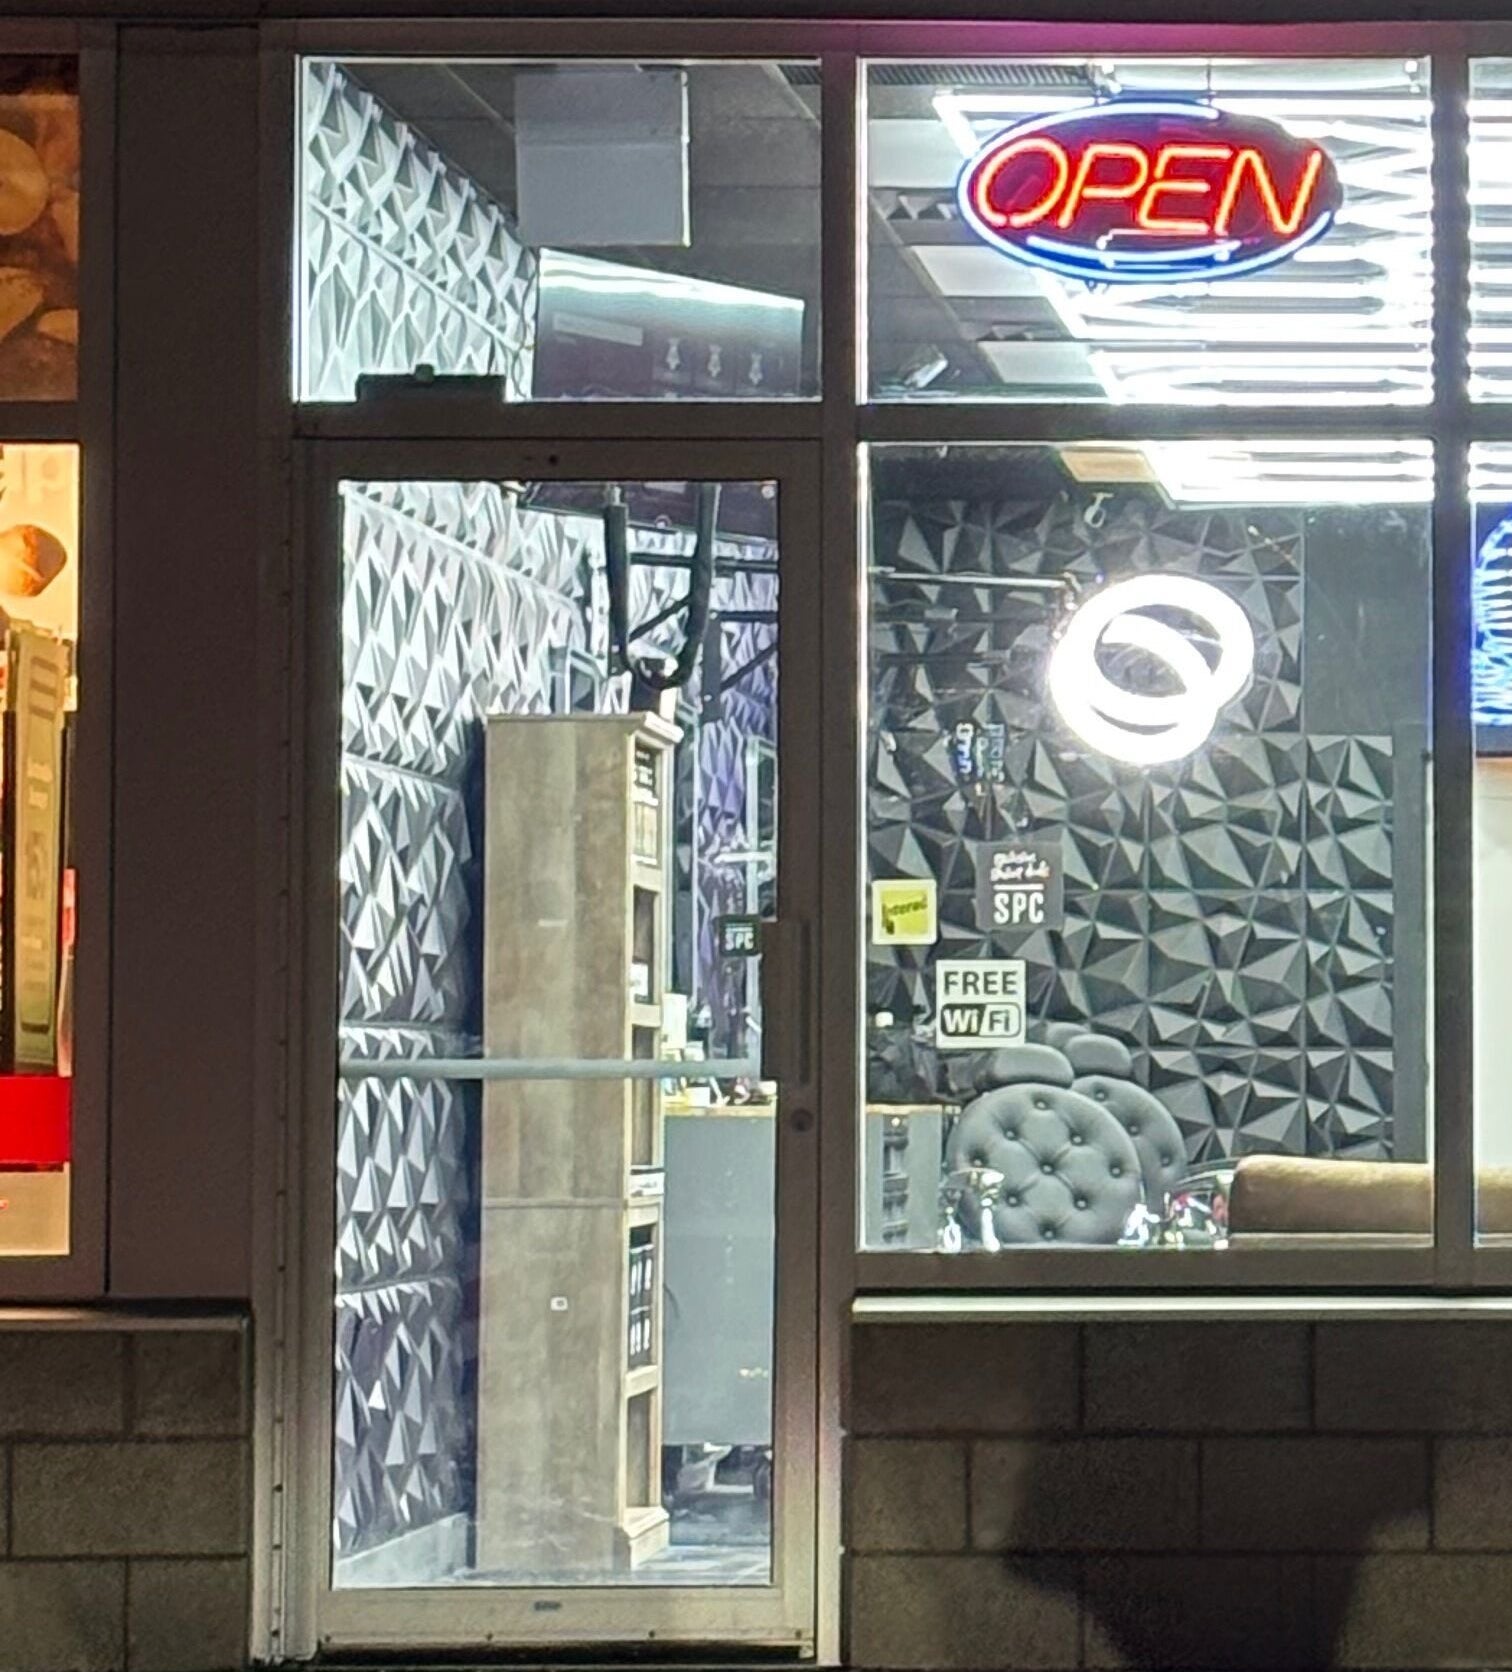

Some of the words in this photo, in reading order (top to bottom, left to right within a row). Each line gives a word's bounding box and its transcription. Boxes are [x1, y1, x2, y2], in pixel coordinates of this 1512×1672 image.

[975, 136, 1323, 236] OPEN
[993, 892, 1044, 924] SPC
[943, 971, 1018, 995] FREE
